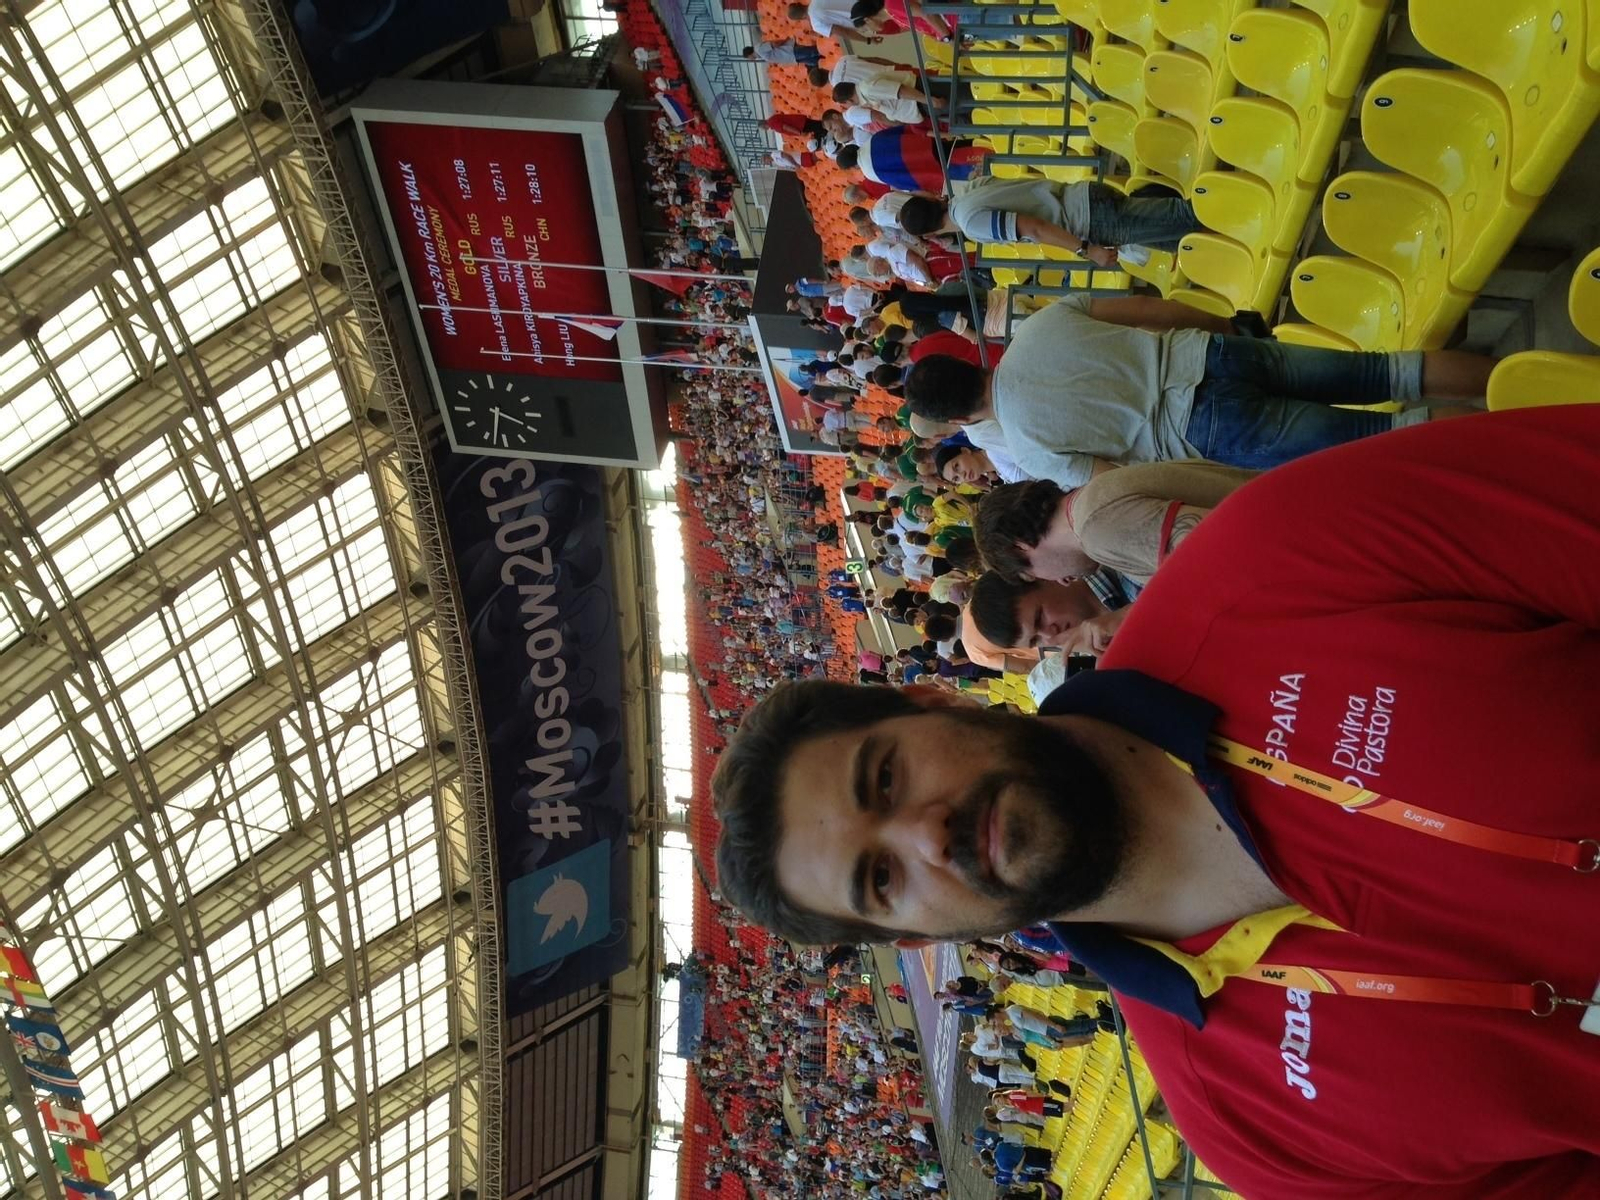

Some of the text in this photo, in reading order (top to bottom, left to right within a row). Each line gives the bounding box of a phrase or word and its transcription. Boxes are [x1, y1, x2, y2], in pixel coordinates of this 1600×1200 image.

[454, 160, 472, 200] 1:27:08
[489, 162, 508, 202] 1:27:11
[467, 212, 481, 236] RUS
[502, 215, 516, 238] RUS
[398, 160, 457, 336] WOMEN'S 20 Km RACE WALK
[428, 205, 462, 301] MEDAL CEREMONY
[458, 239, 477, 275] GOLD
[490, 236, 512, 282] SILVER
[524, 234, 546, 288] BRONZE
[525, 164, 575, 366] Hong LIU CHN 1:28:10
[480, 264, 505, 334] LASHMANOVA
[846, 563, 863, 572] 3
[480, 458, 584, 840] #Moscow2013
[1332, 695, 1368, 770] Divina
[1356, 686, 1396, 777] Pastora
[1246, 756, 1273, 770] IAAF
[1294, 773, 1316, 786] adidas
[1404, 810, 1445, 832] iaaf.org
[1262, 970, 1286, 980] IAAF
[1356, 979, 1395, 994] iaaf.org
